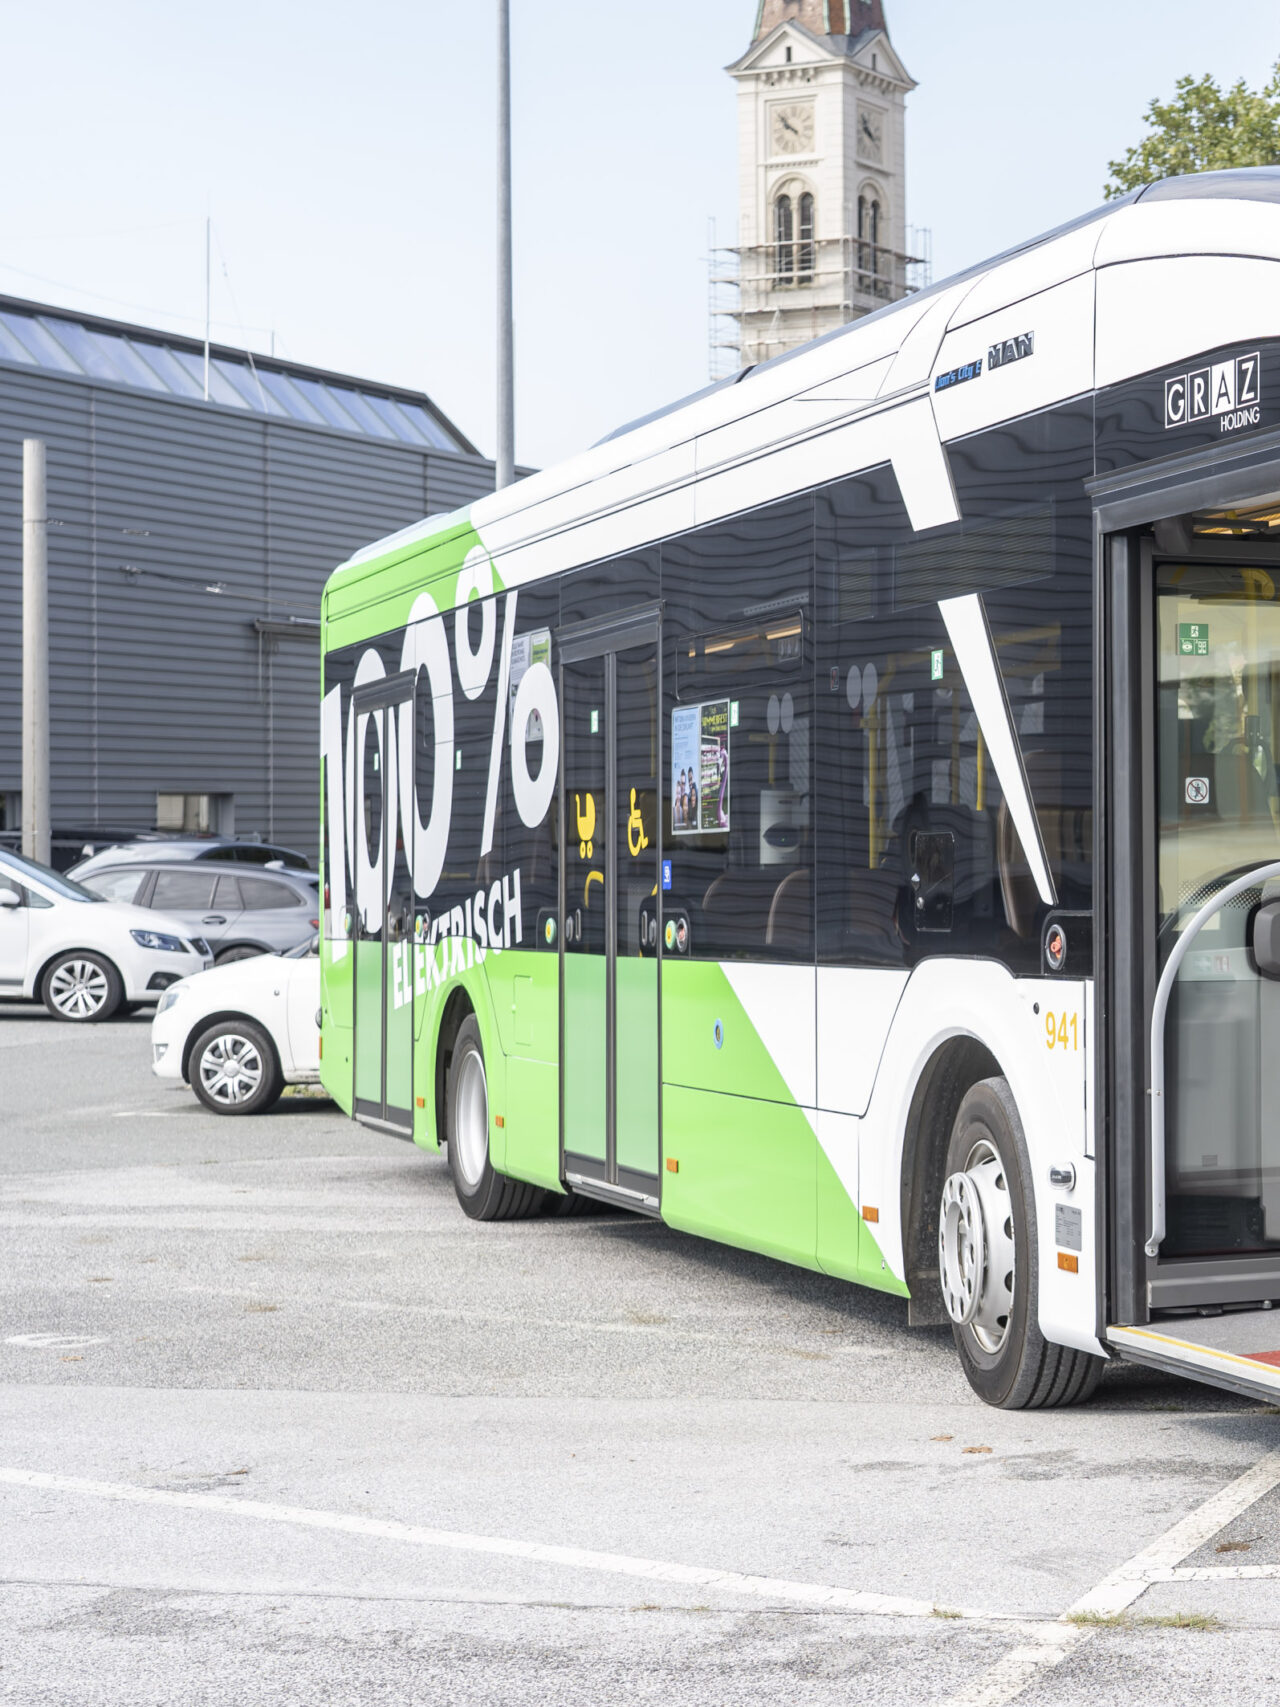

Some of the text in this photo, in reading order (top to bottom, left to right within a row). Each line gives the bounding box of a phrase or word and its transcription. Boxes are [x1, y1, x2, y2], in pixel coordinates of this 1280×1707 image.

[957, 364, 974, 380] City
[975, 359, 983, 374] E
[987, 330, 1035, 371] MAN
[1166, 356, 1258, 426] GRAZ
[1220, 406, 1260, 433] HOLDING
[320, 544, 559, 963] 100%
[393, 867, 523, 1011] ELEKTRISCH
[1045, 1011, 1078, 1051] 941
